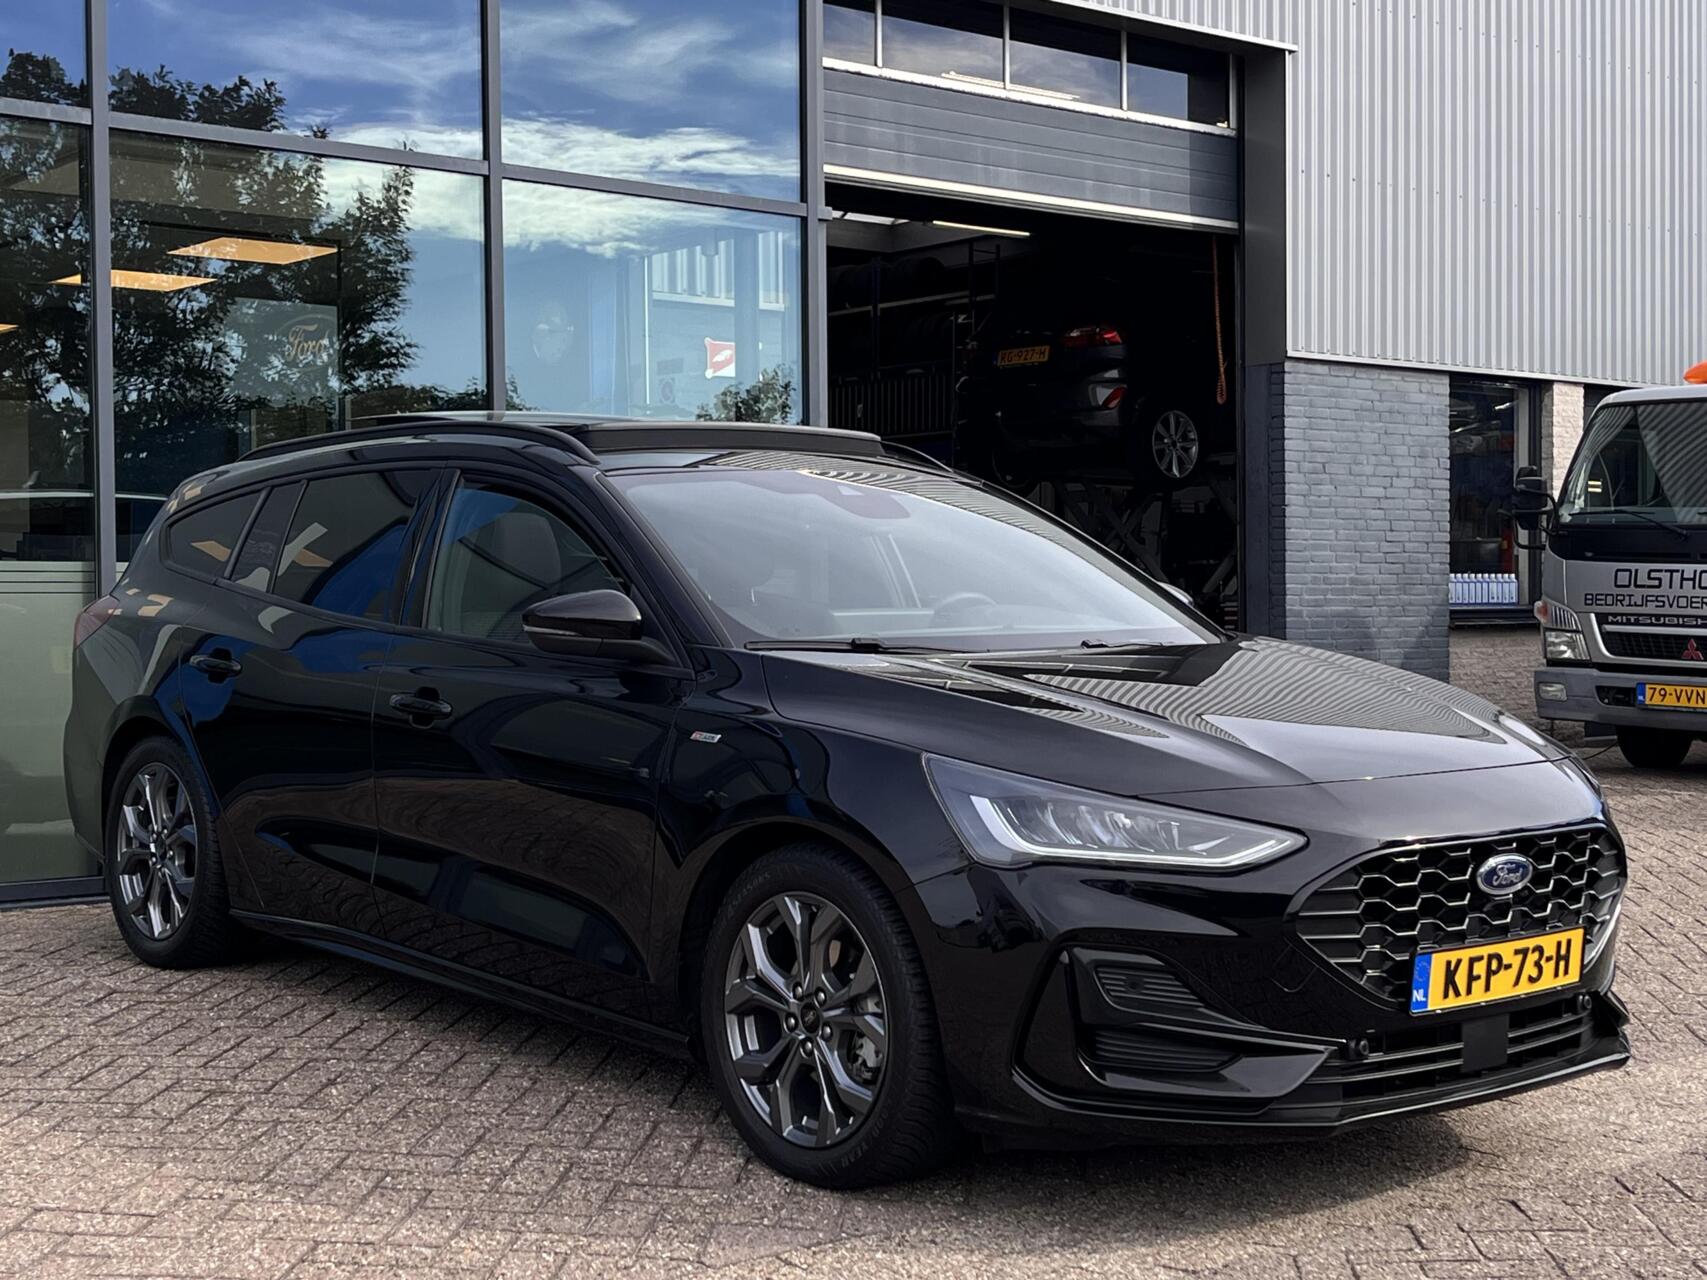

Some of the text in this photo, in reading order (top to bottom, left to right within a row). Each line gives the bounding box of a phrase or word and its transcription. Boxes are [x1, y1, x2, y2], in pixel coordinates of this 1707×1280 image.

[285, 324, 330, 361] Ford
[1584, 593, 1707, 609] BEDRIJFSVOER
[1608, 615, 1707, 625] MITSUBISH
[1648, 687, 1706, 704] 79-VVN
[1492, 863, 1522, 886] Ford
[1442, 938, 1572, 1000] KFP-73-H
[1412, 989, 1426, 1001] NL
